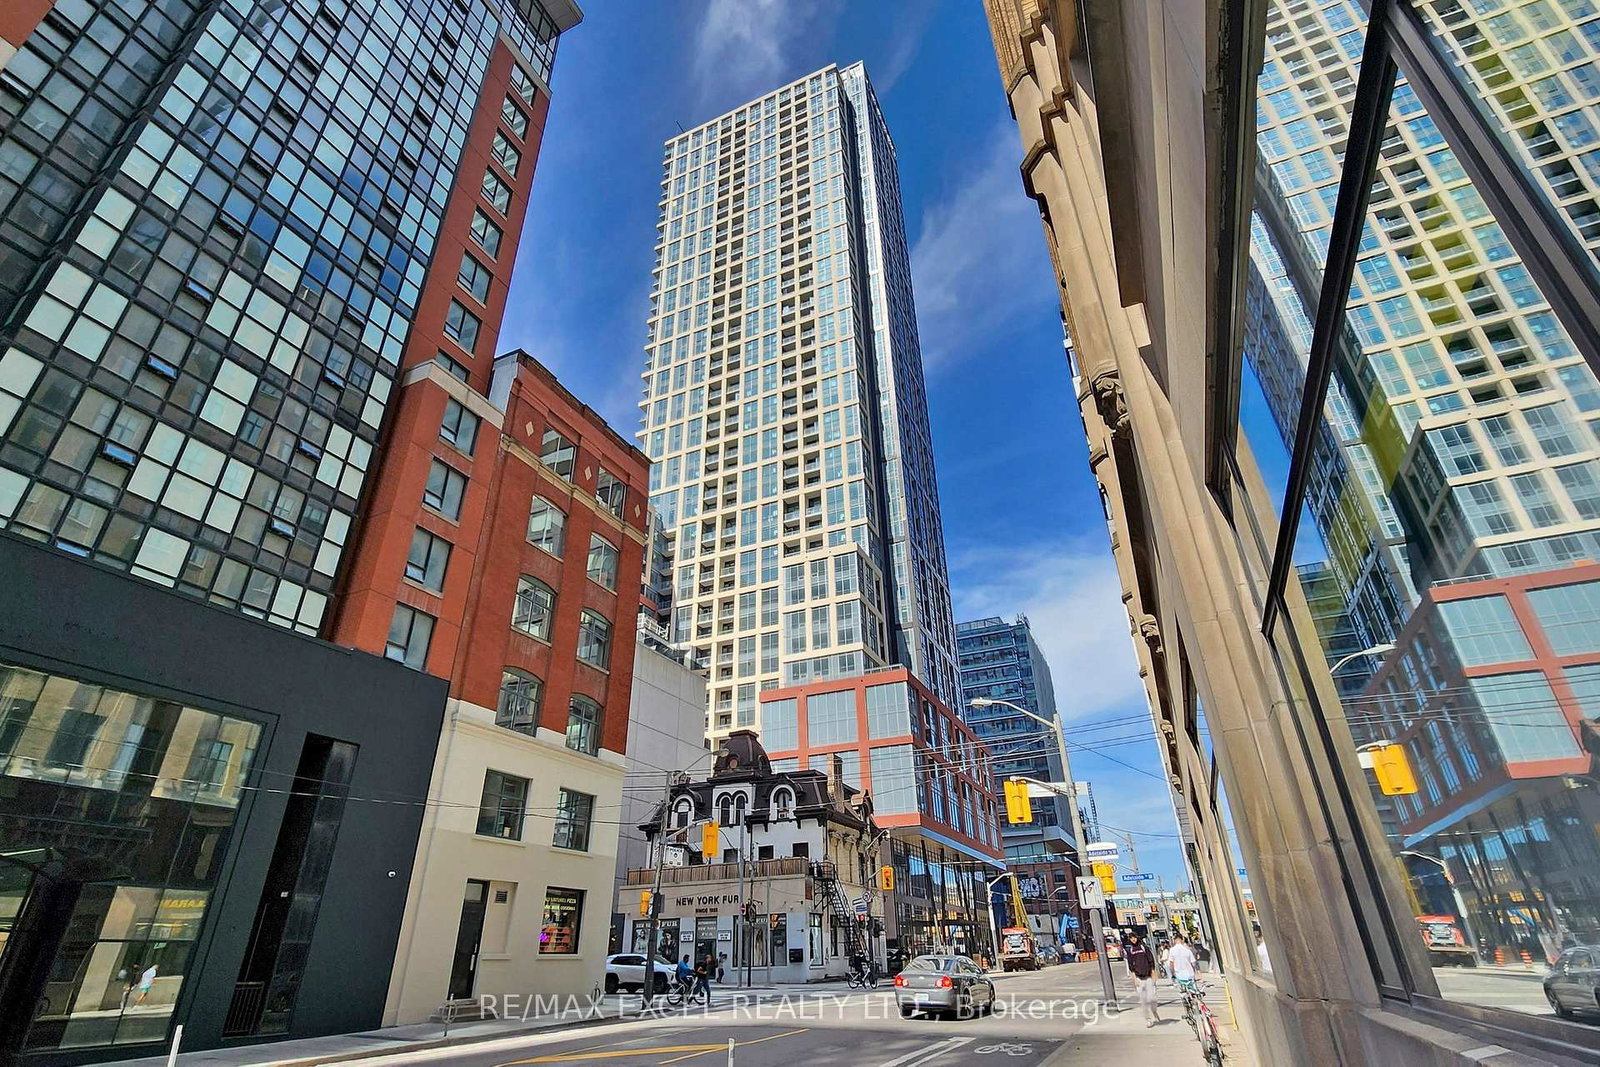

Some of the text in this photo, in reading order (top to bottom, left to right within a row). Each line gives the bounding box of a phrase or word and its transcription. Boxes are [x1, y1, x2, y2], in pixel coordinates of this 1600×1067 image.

[676, 894, 739, 906] NEW YORK FUR
